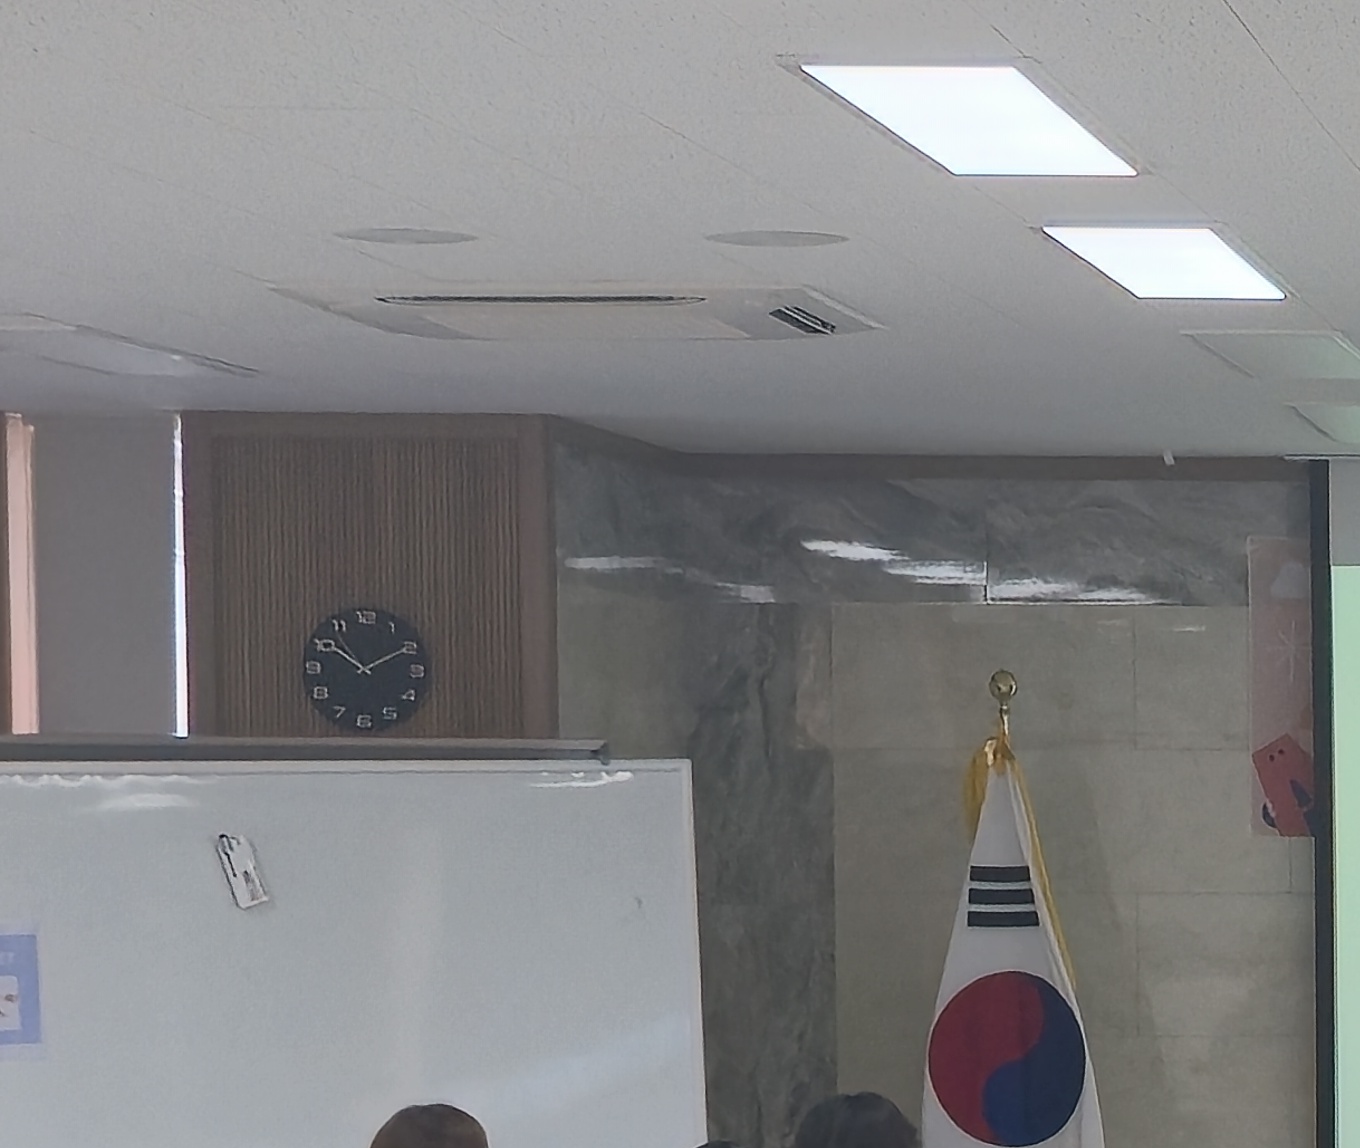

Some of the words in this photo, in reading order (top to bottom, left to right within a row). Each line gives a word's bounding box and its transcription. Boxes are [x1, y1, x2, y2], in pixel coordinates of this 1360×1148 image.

[355, 610, 377, 625] 12
[331, 619, 347, 632] 11
[388, 622, 395, 634] 1
[314, 638, 336, 652] 10
[403, 641, 417, 655] 2
[306, 661, 321, 675] 9
[410, 664, 425, 678] 3
[313, 686, 329, 699] 8
[401, 689, 416, 701] 4
[332, 705, 347, 718] 7
[382, 707, 398, 720] 5
[356, 714, 373, 728] 6
